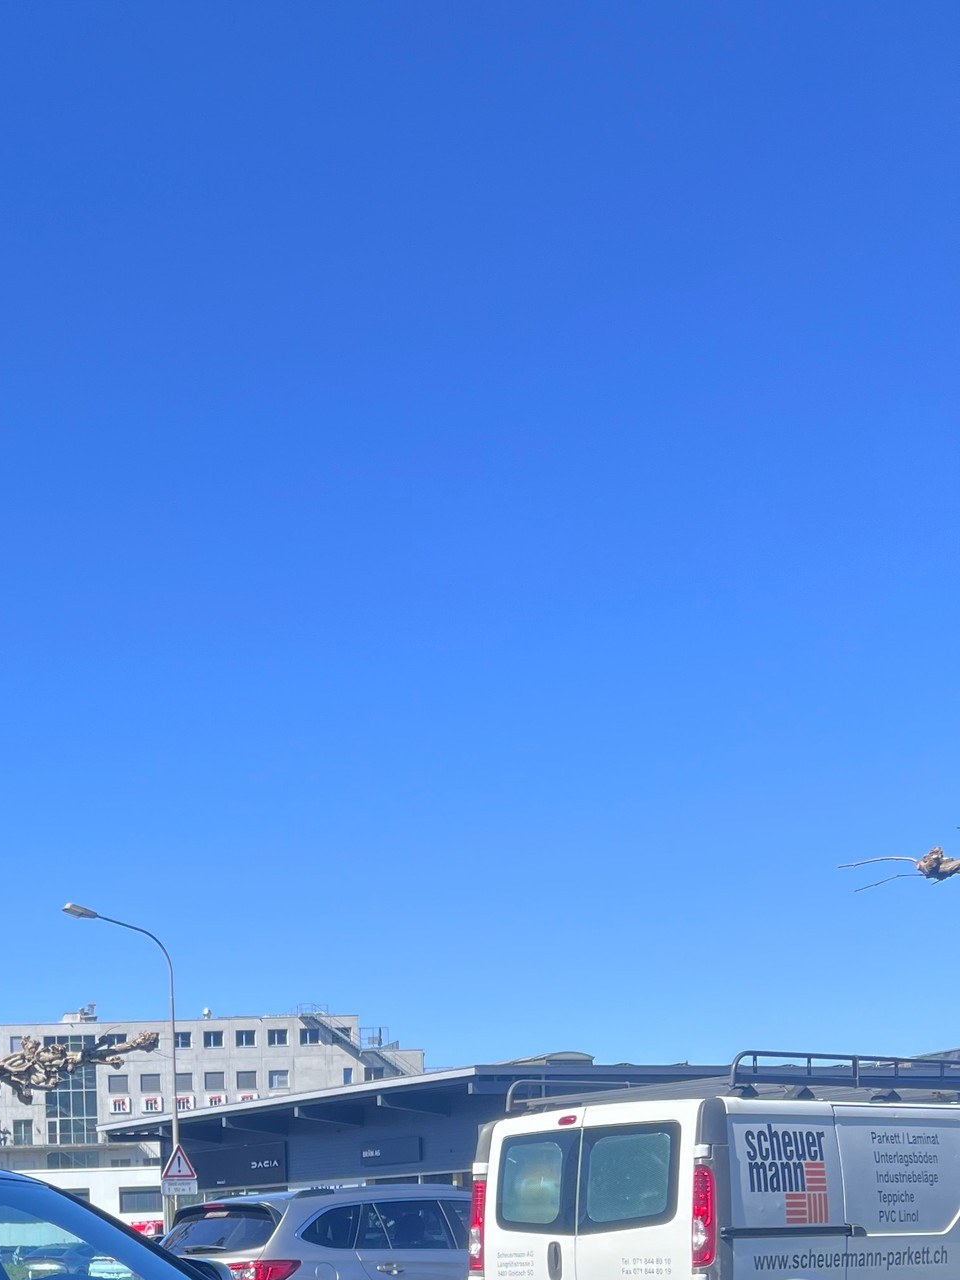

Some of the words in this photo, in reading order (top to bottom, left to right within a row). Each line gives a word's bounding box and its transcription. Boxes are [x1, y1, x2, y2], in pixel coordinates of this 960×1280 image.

[745, 1124, 825, 1161] scheuer
[871, 1132, 900, 1145] Parkett
[907, 1132, 939, 1145] Laminat
[250, 1160, 279, 1169] DACIA
[874, 1151, 938, 1167] Unterlagsböden
[748, 1161, 806, 1193] mann
[876, 1170, 939, 1186] Industriebeläge
[878, 1190, 915, 1206] Teppiche
[879, 1211, 897, 1223] PVC
[898, 1210, 919, 1223] Linol
[754, 1246, 948, 1271] www.scheuermann-parkett.ch
